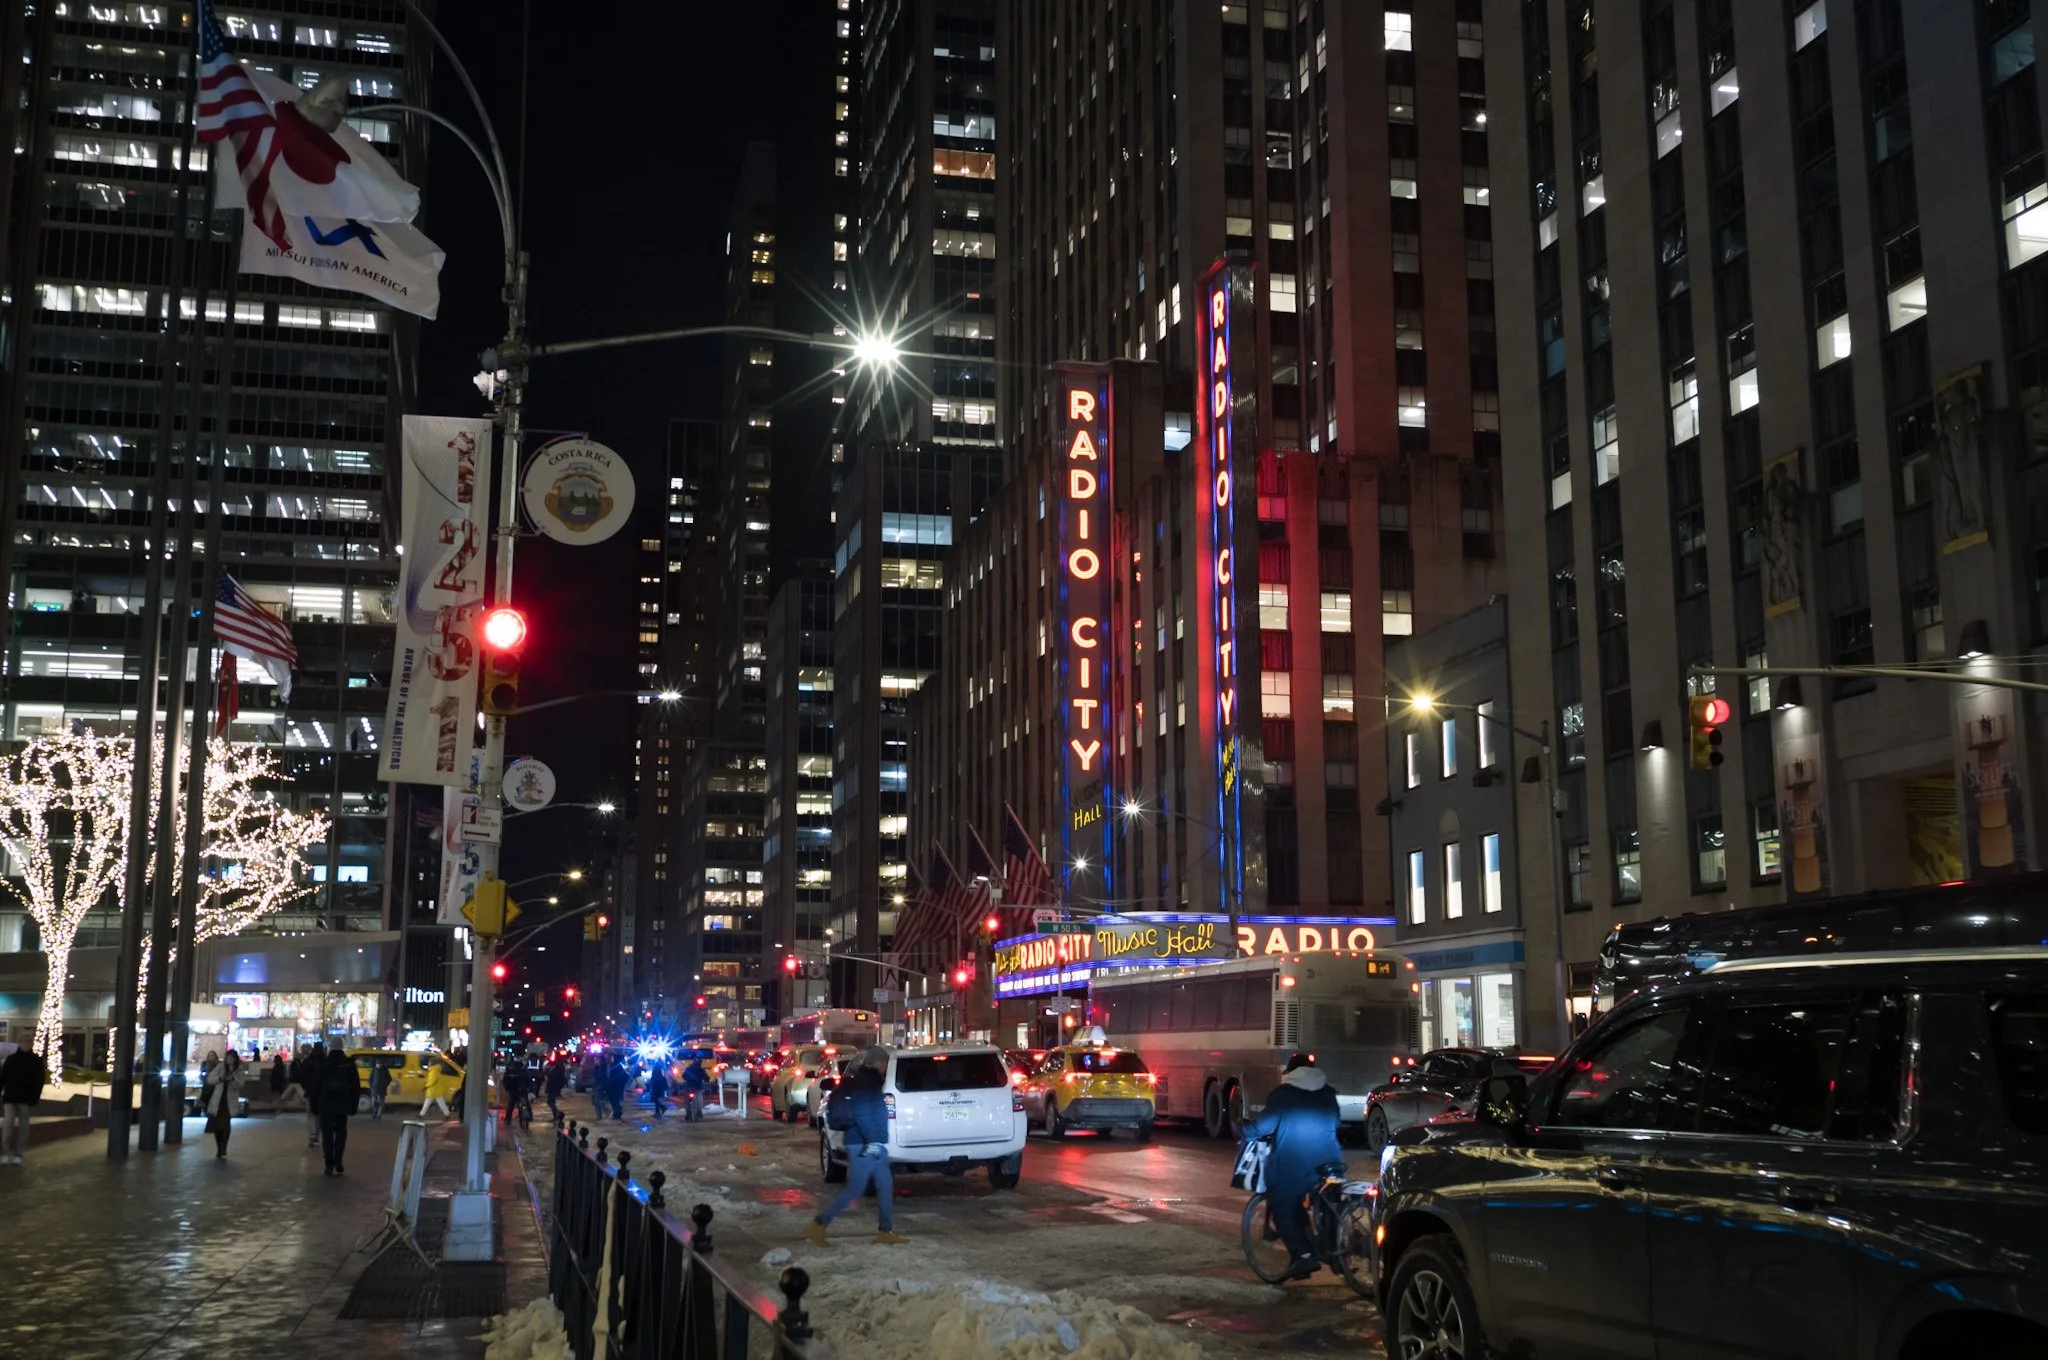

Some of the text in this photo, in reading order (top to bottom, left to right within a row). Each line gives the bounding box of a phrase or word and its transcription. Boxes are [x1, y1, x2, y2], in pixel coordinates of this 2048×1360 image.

[265, 247, 307, 265] MITSUI
[351, 265, 408, 296] AMERICA
[1213, 290, 1229, 507] RADIO
[548, 449, 611, 468] COSTA RICA
[1068, 389, 1101, 771] RADIO CITY
[1217, 548, 1234, 726] CITY
[390, 648, 414, 770] AVENUE OF THE AMERICAS
[1074, 803, 1101, 831] HALL
[1052, 924, 1081, 933] W 50 St
[1097, 923, 1216, 959] Music Hall
[1236, 926, 1375, 956] RADIO
[1020, 938, 1056, 969] RADIO
